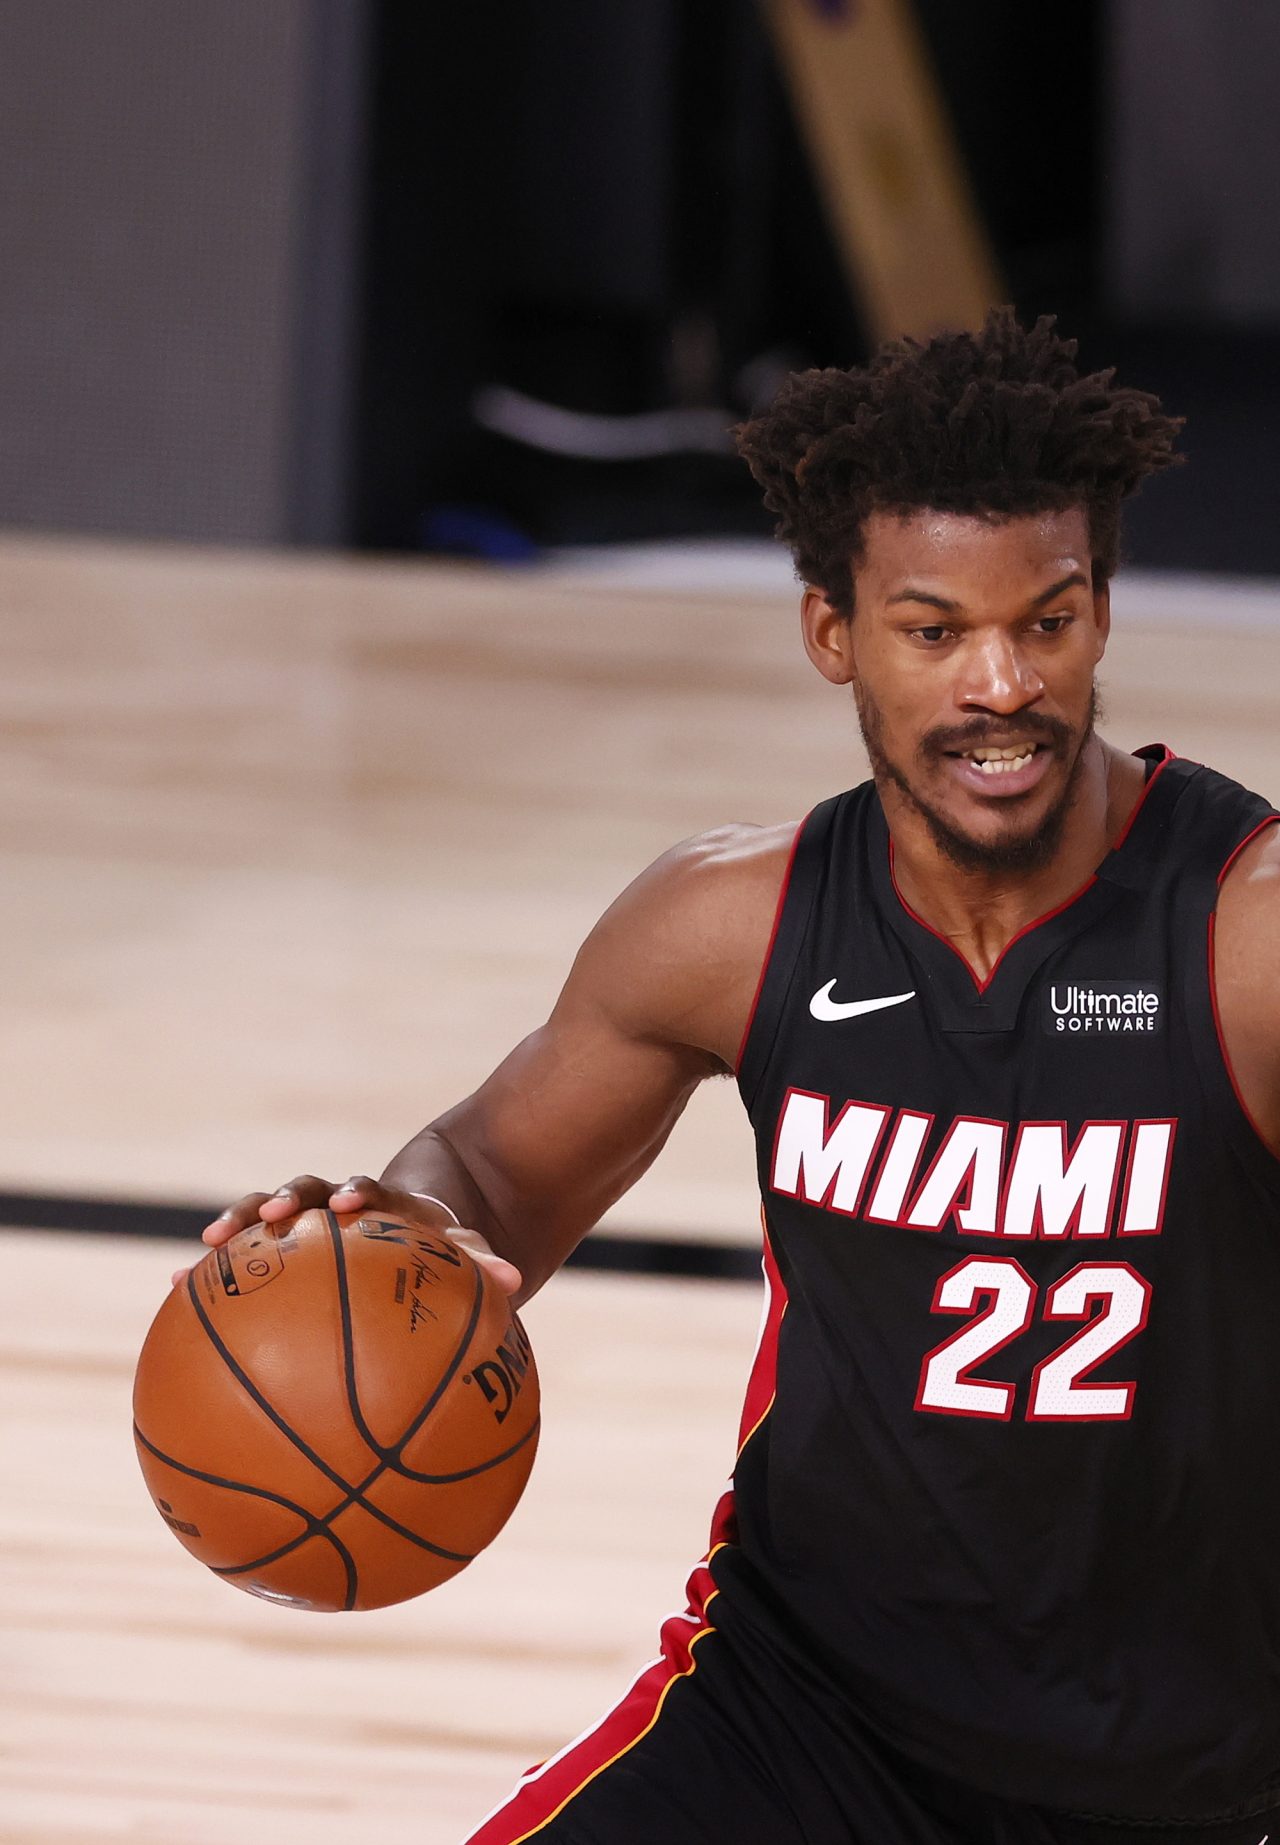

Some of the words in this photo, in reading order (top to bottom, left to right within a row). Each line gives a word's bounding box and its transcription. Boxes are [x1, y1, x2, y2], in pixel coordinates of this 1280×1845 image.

[1050, 986, 1159, 1015] Ultimate
[1056, 1017, 1155, 1032] SOFTWARE
[769, 1087, 1178, 1240] MIAMI
[914, 1254, 1153, 1422] 22
